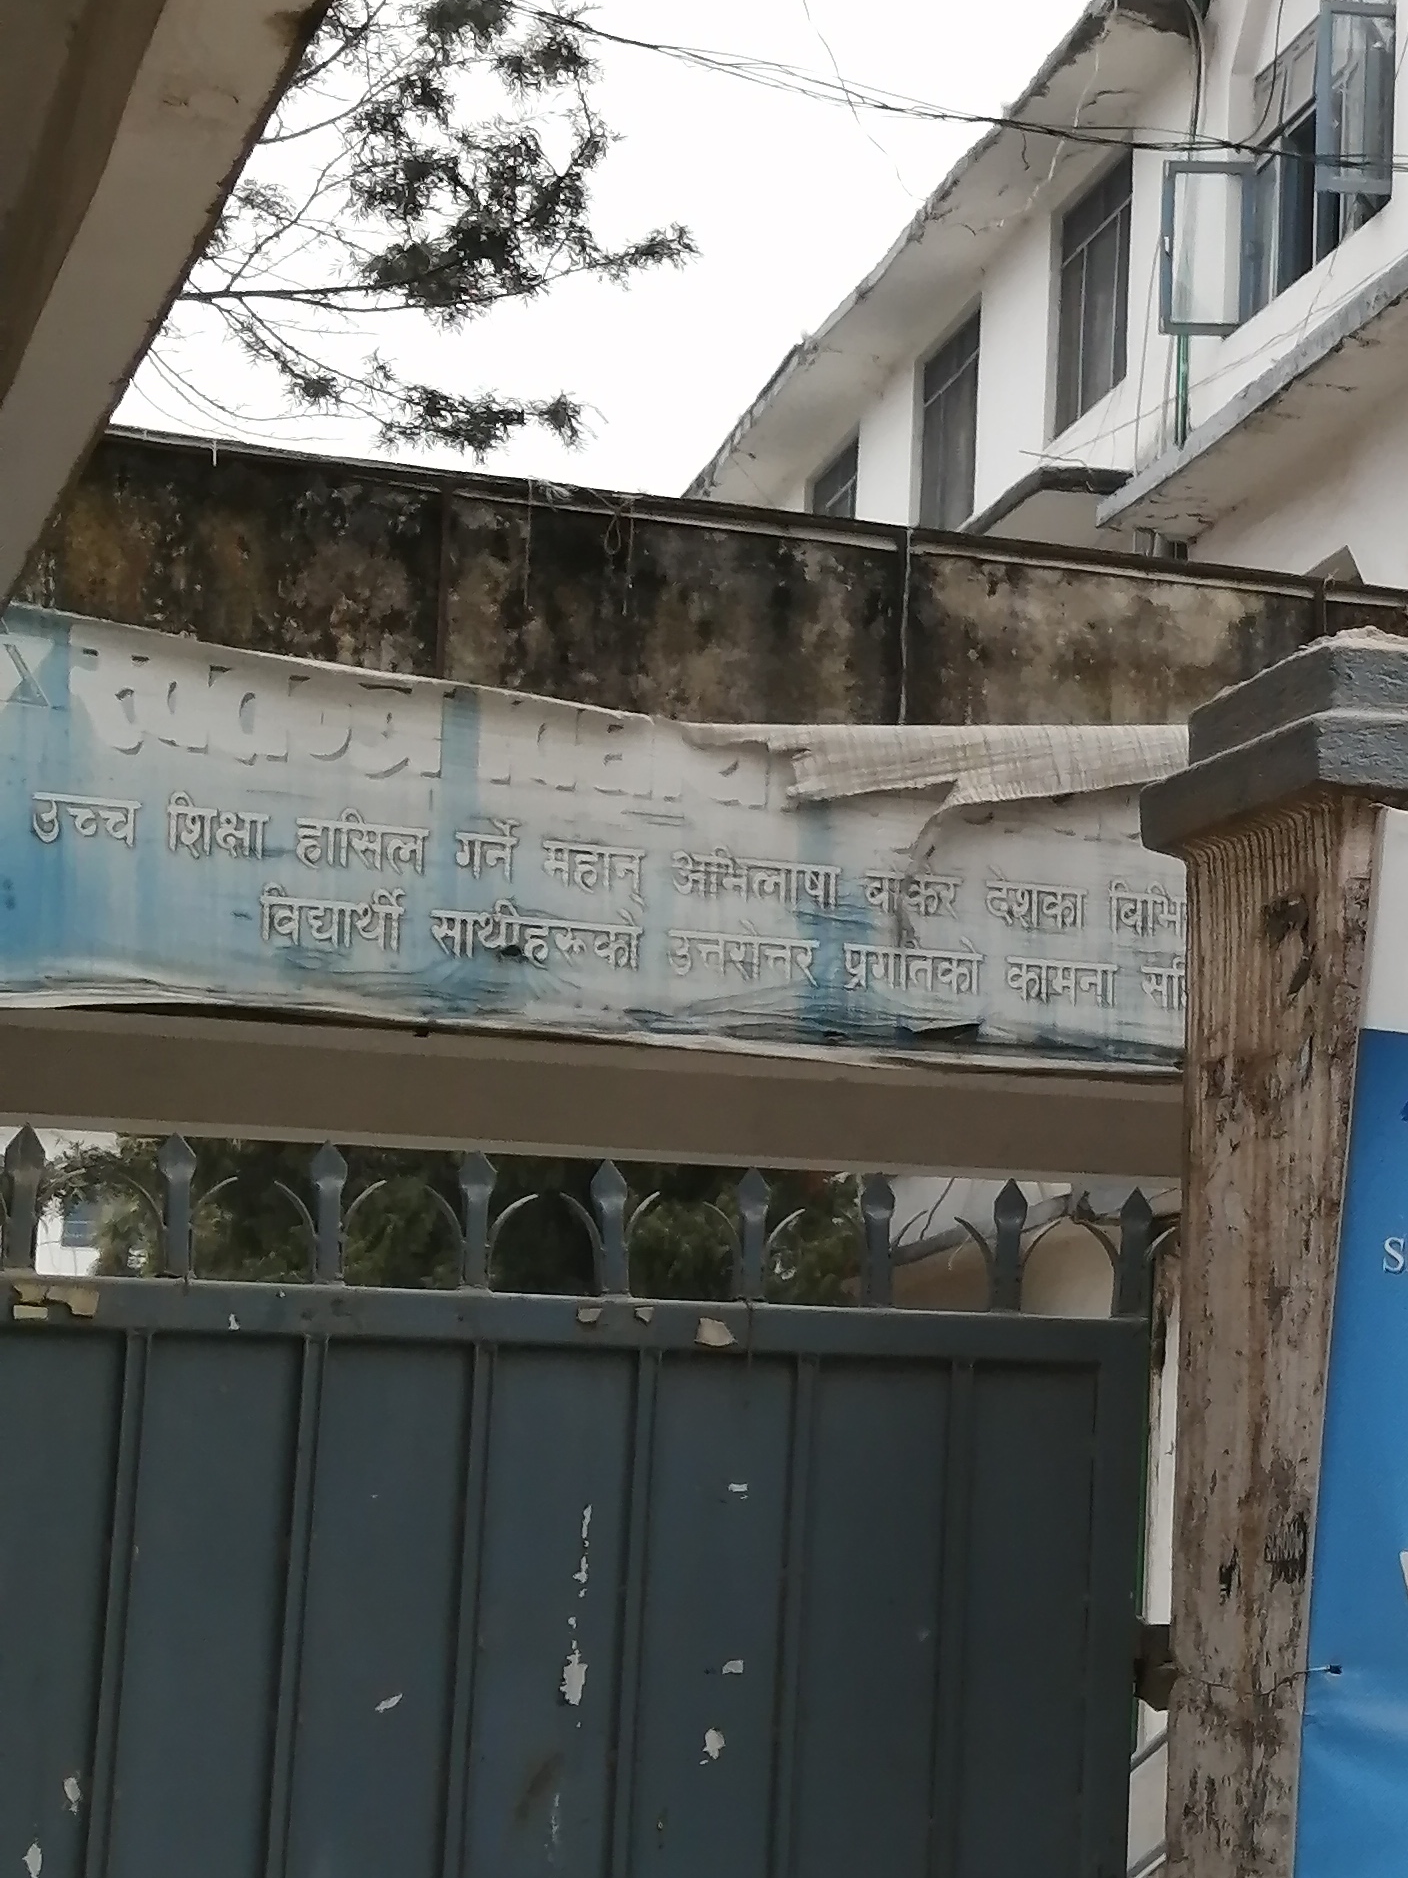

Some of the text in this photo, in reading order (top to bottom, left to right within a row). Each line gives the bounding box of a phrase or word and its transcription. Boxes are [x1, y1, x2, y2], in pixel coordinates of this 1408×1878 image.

[31, 790, 143, 849] उच्च
[166, 789, 271, 861] शिक्षा
[295, 806, 431, 876] हासिल
[454, 816, 521, 884] गर्ने
[542, 837, 648, 914] महान्
[259, 880, 407, 954] विद्यार्थी
[1005, 954, 1121, 1010] कामना
